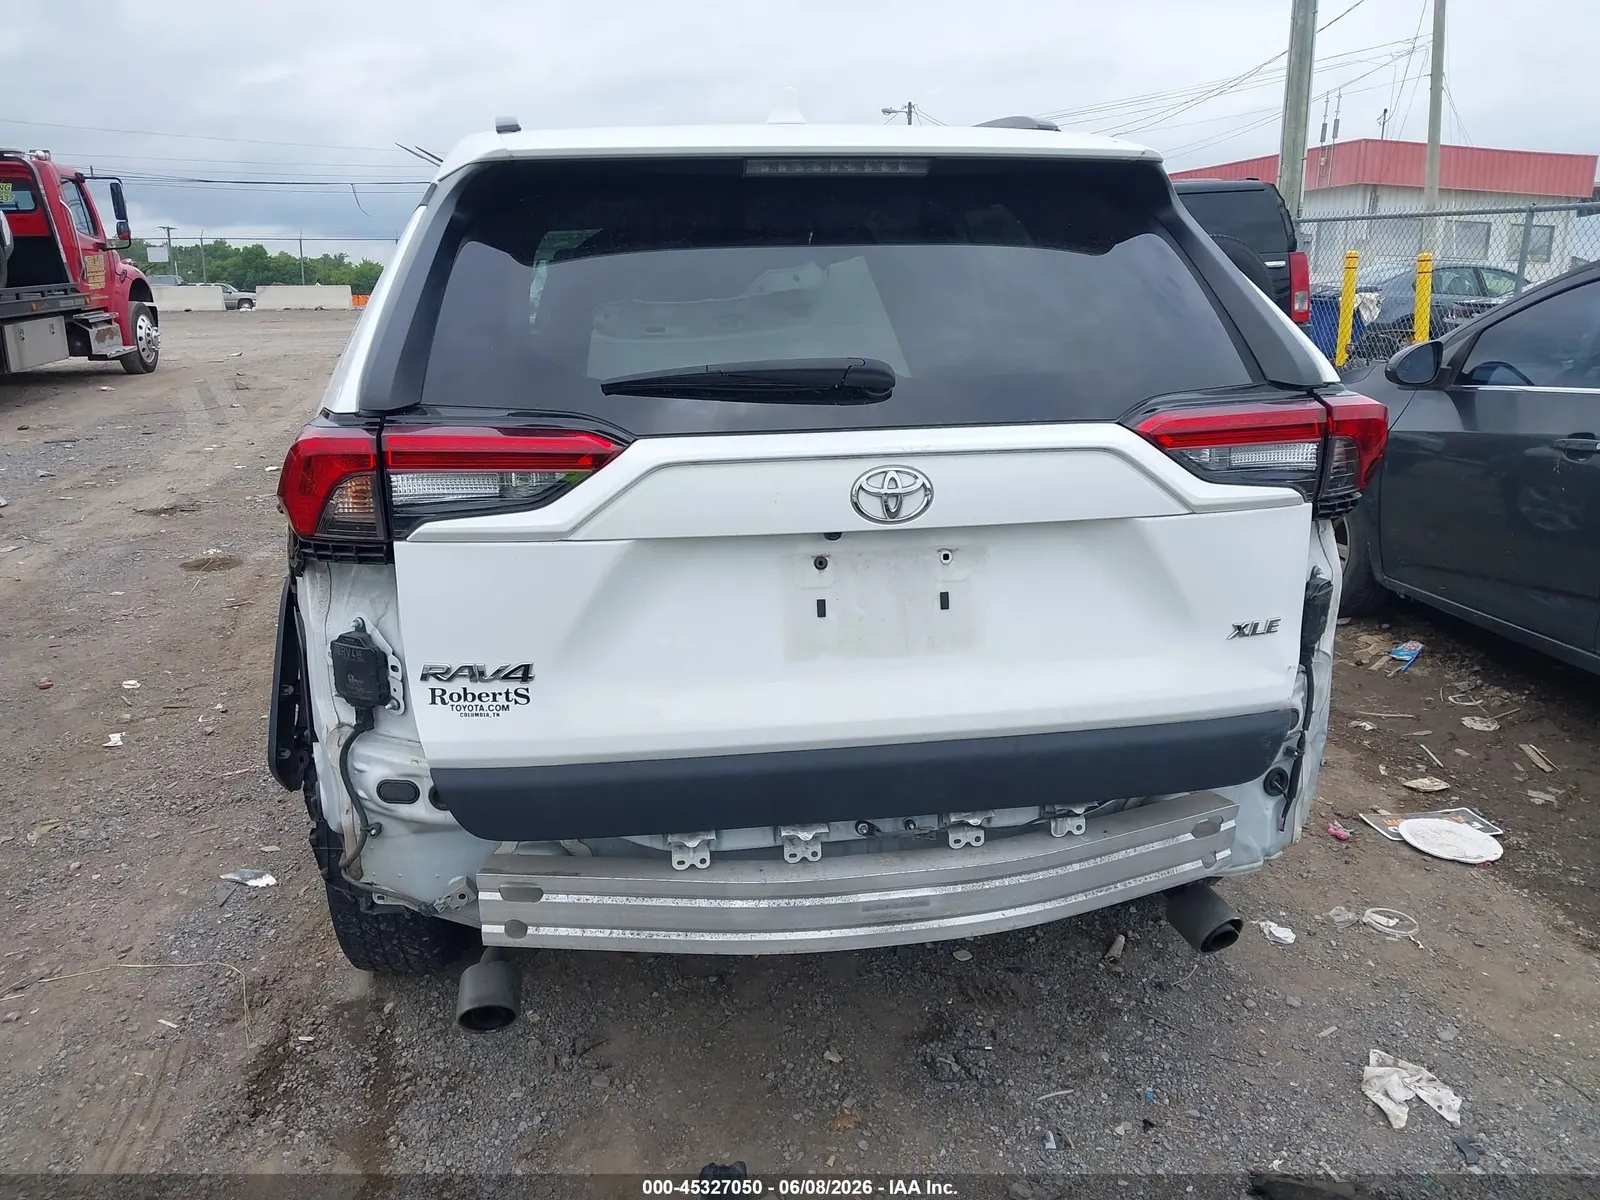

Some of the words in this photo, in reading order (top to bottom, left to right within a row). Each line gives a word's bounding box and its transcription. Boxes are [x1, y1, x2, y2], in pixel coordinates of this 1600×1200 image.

[1226, 618, 1281, 640] XLE
[420, 662, 535, 683] RAV4
[428, 687, 531, 705] RobertS
[450, 704, 510, 712] TOYOTA.COM
